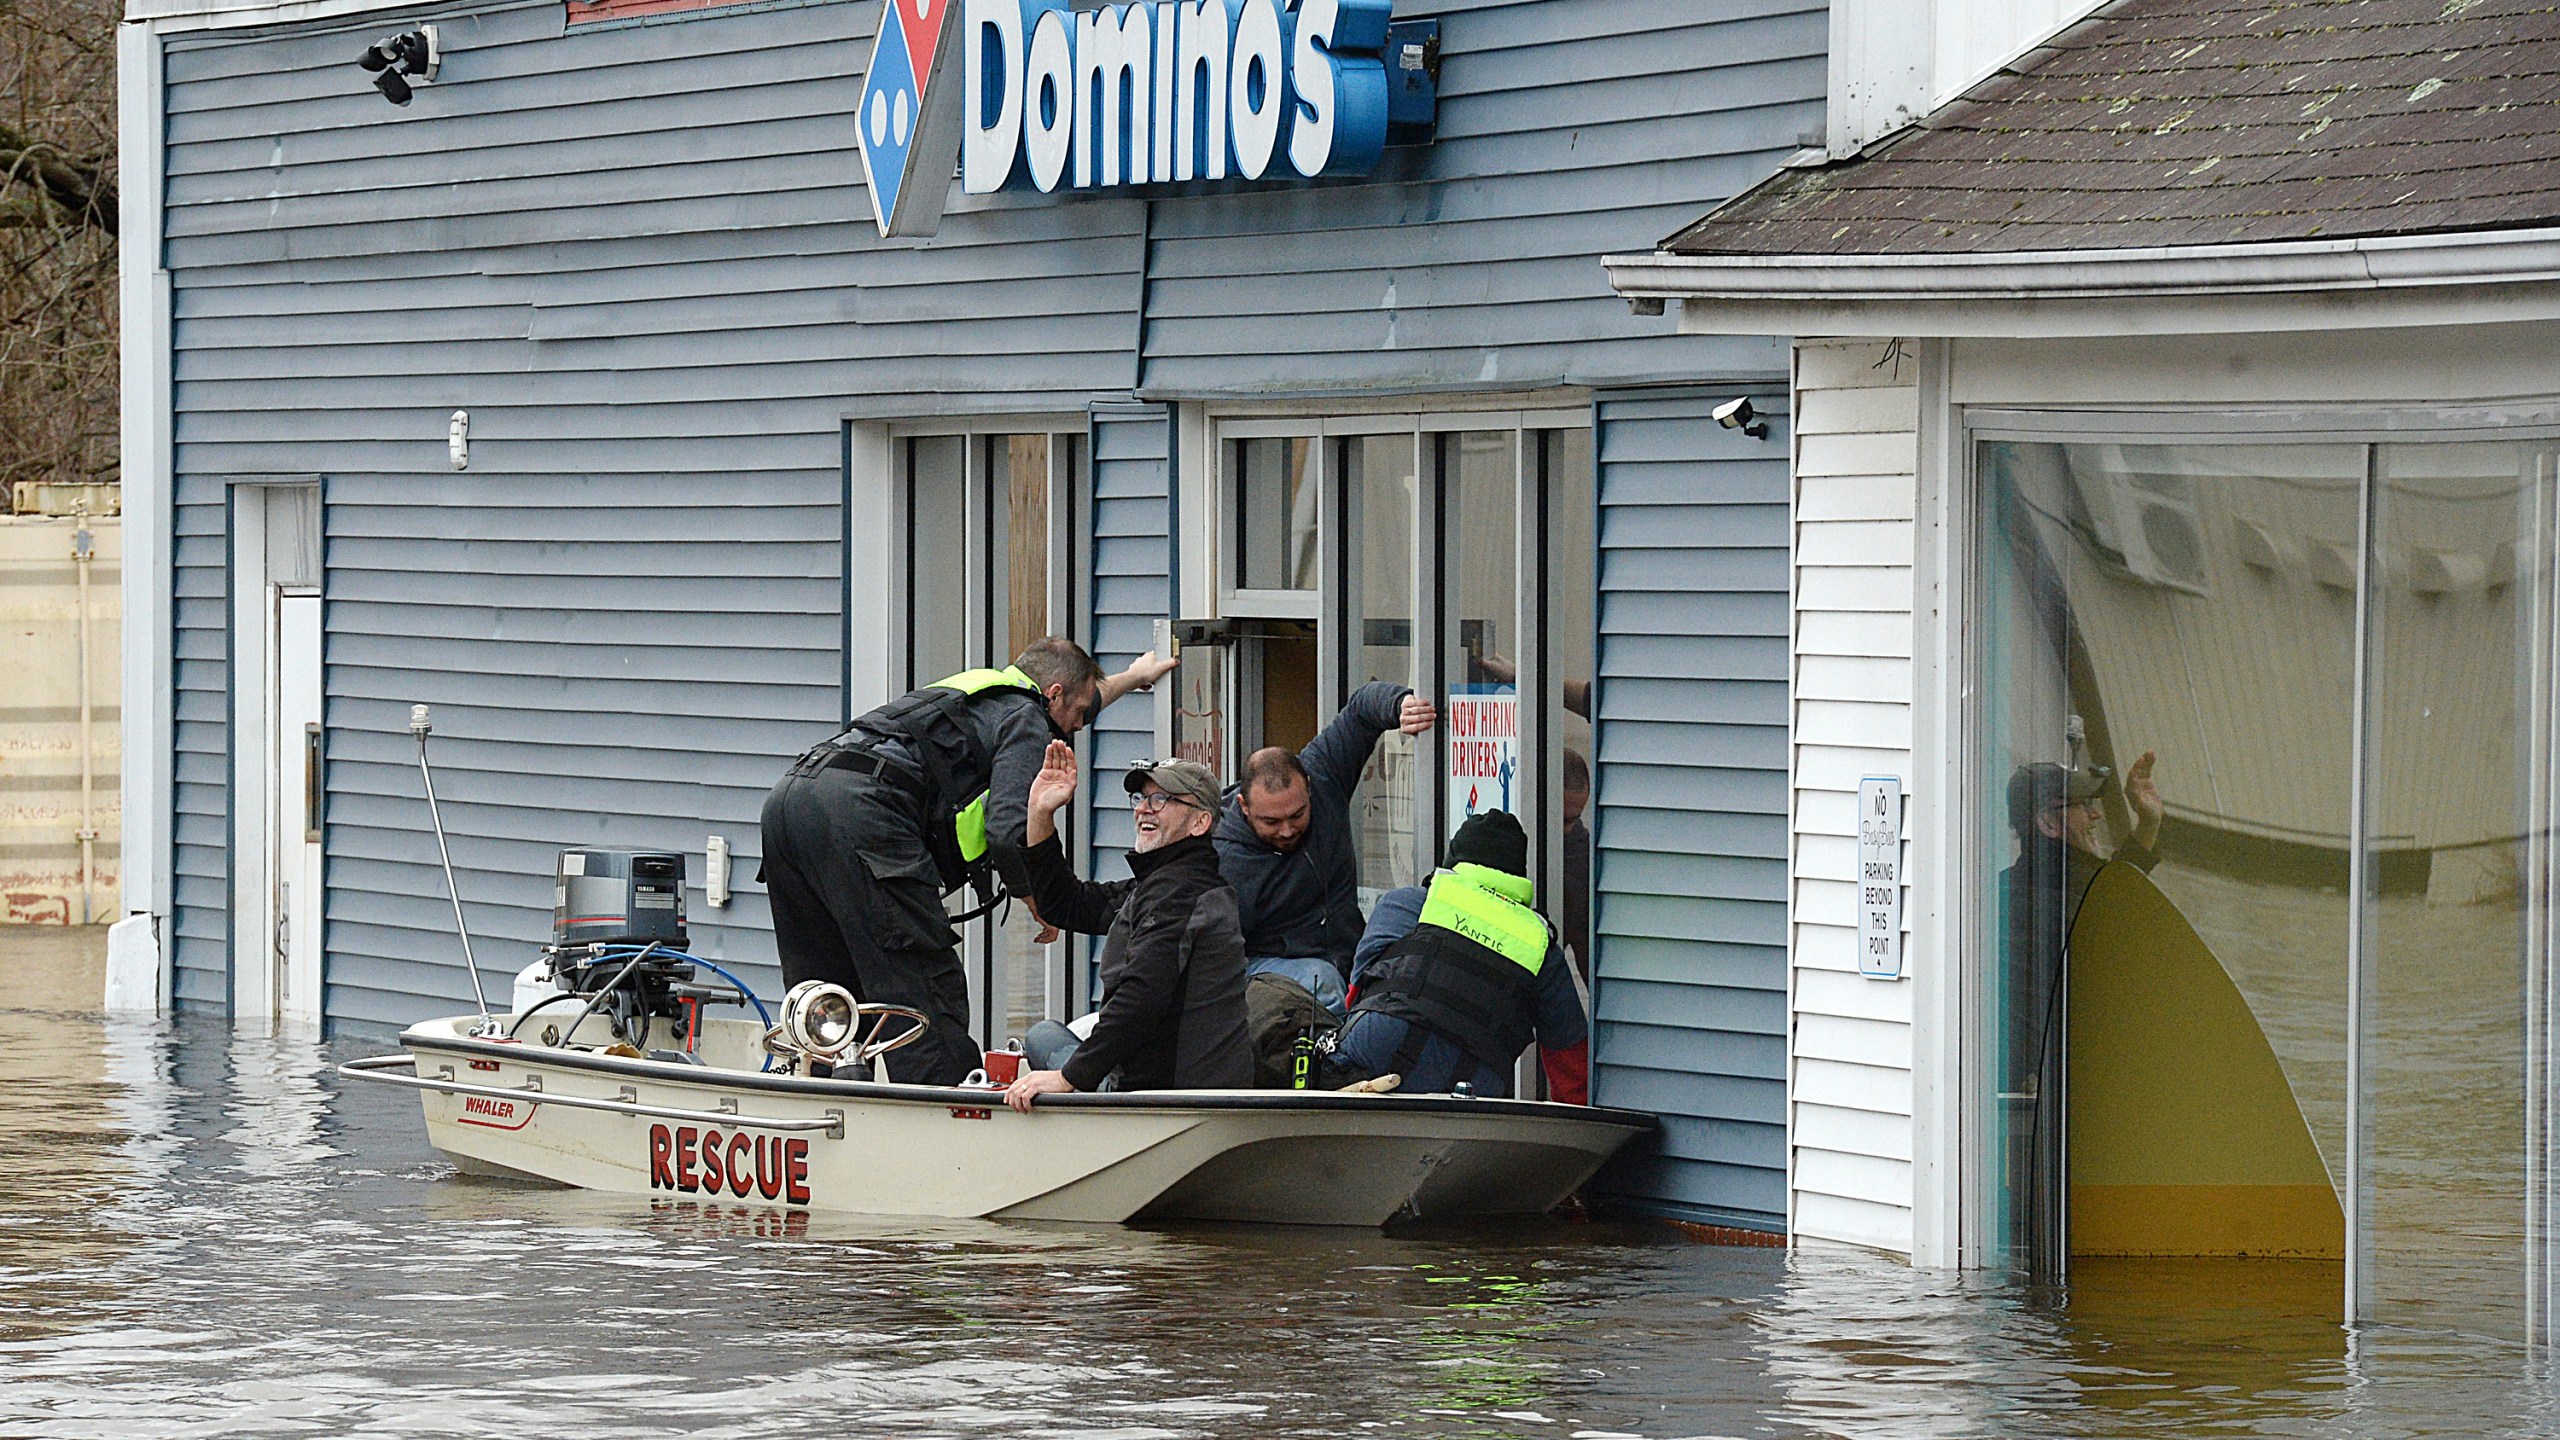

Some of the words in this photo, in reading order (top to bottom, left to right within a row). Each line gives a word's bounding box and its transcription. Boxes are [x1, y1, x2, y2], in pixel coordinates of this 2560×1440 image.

[1452, 701, 1478, 737] NOW
[1452, 741, 1498, 778] DRIVERS
[1874, 794, 1887, 816] NO
[1865, 862, 1893, 881] PARKING
[1865, 886, 1893, 906] BEYOND
[1871, 912, 1887, 931] THIS
[1454, 913, 1504, 953] YANTIC
[1869, 936, 1889, 955] POINT
[465, 1096, 514, 1119] WHALER
[650, 1123, 811, 1205] RESCUE
